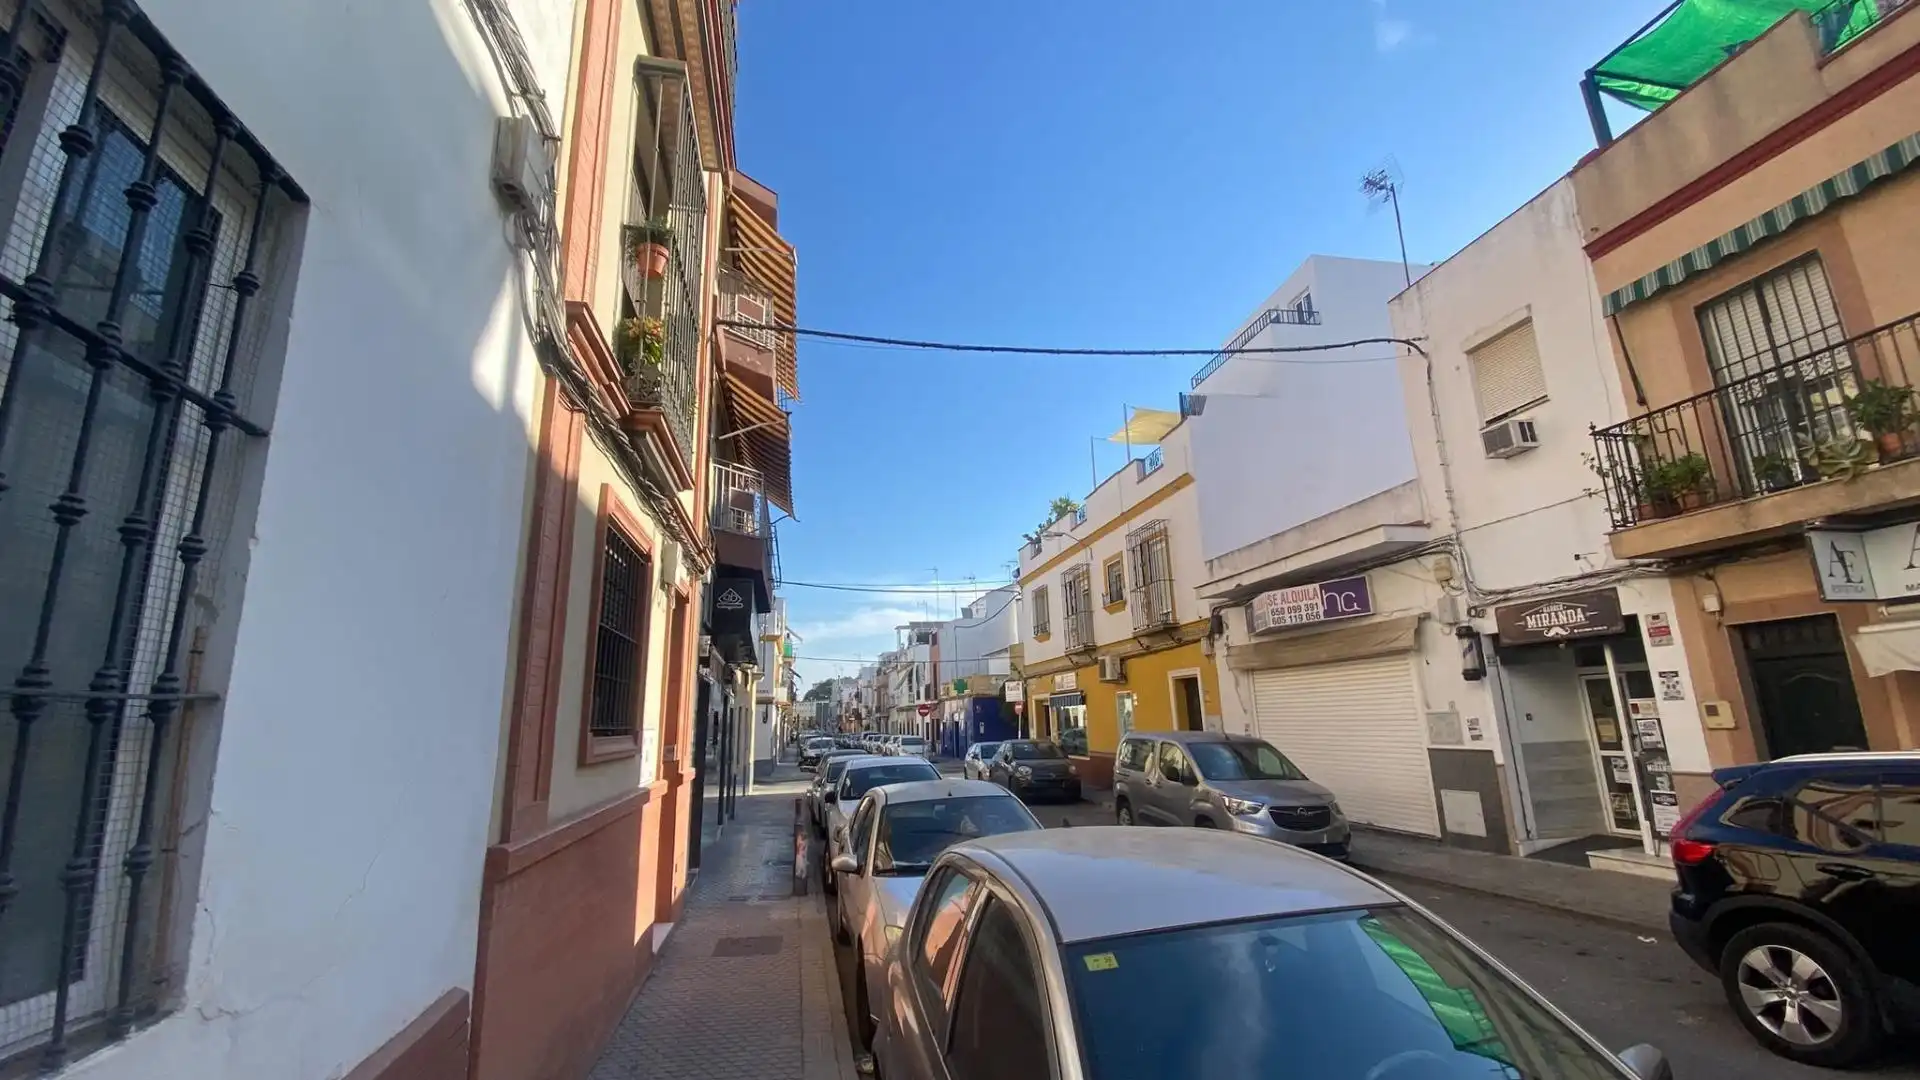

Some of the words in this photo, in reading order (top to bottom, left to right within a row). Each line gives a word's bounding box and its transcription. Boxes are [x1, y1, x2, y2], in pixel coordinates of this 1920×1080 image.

[1267, 593, 1278, 607] SE
[1281, 588, 1319, 605] ALQUILA
[1287, 604, 1302, 615] 099
[1304, 602, 1319, 612] 391
[1271, 616, 1287, 626] 605
[1289, 613, 1304, 624] 119
[1305, 611, 1321, 621] 056
[1525, 607, 1586, 629] MIRANDA
